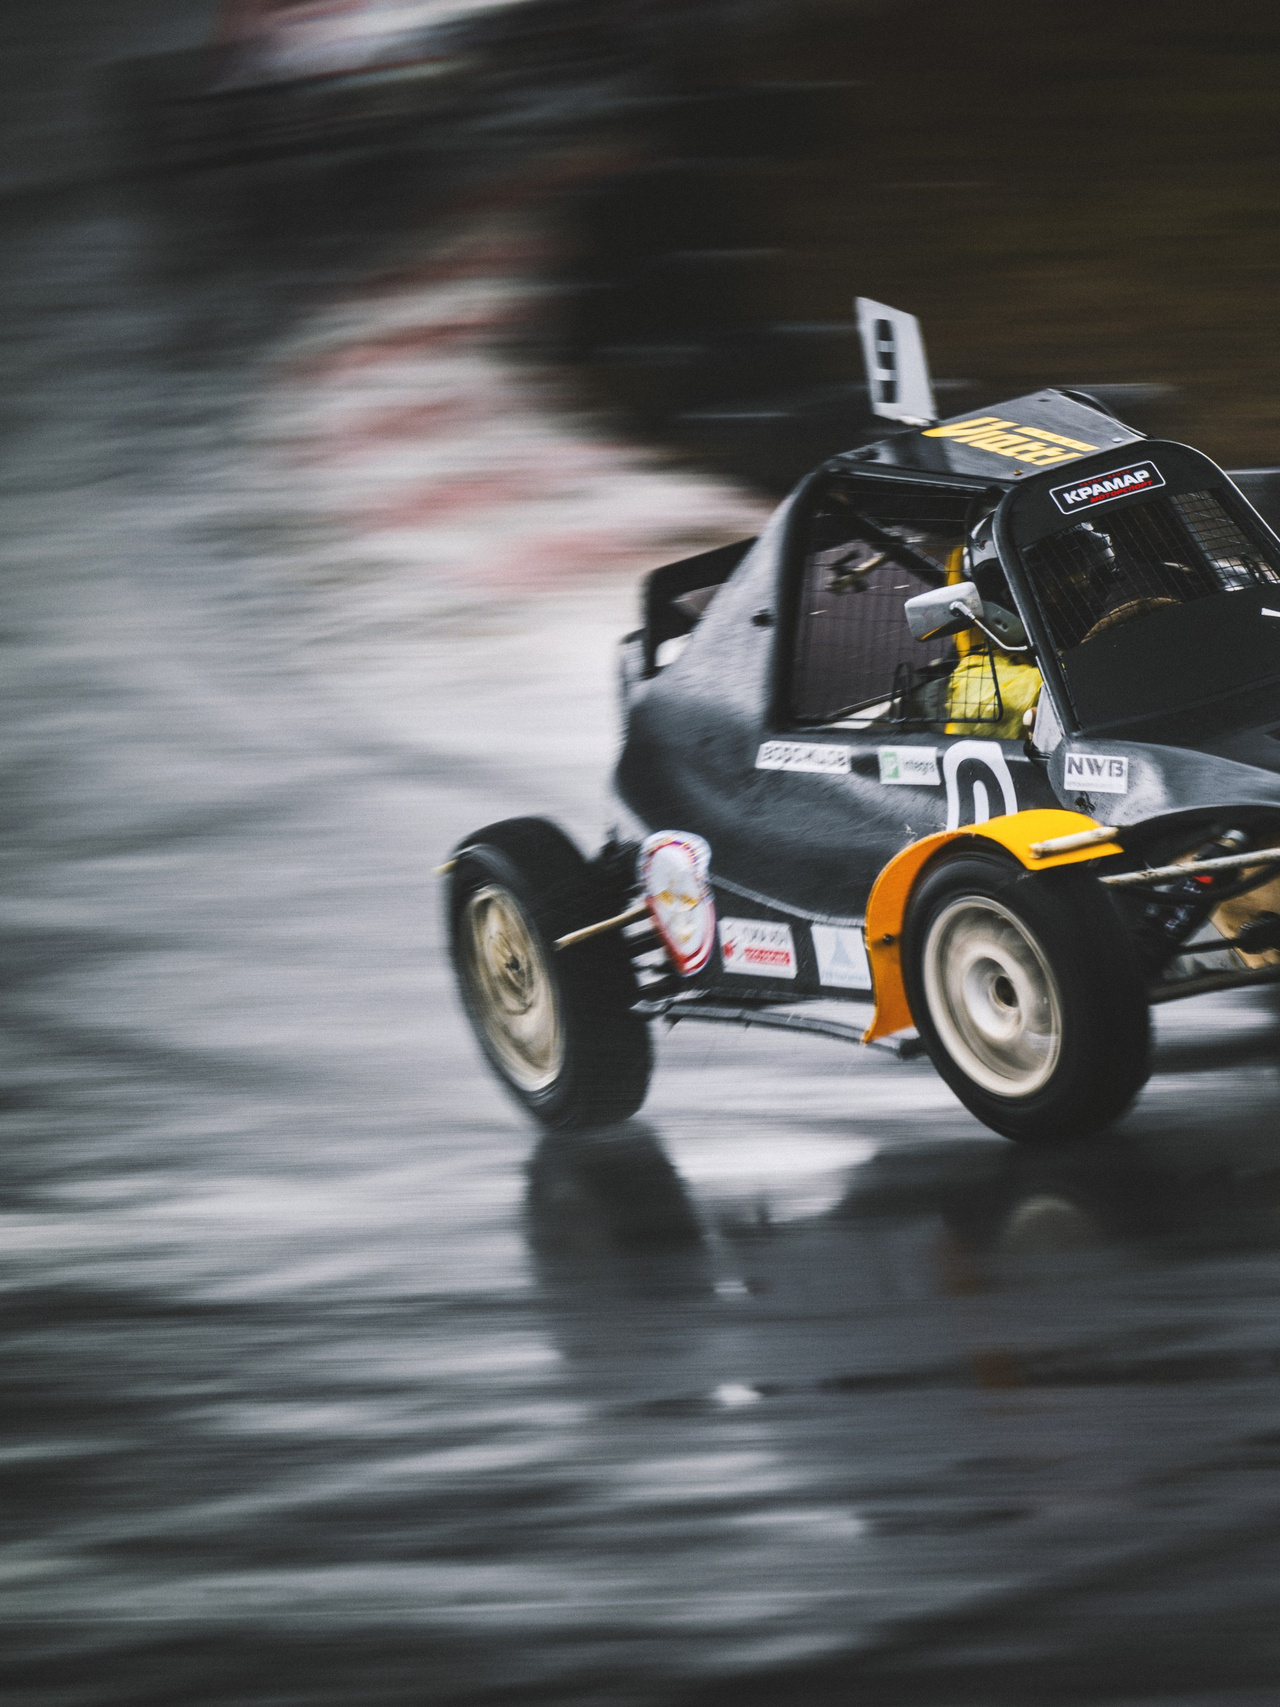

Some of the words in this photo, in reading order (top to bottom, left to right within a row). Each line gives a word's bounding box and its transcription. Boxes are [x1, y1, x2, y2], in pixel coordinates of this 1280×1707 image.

[921, 416, 1100, 467] Viatti
[1063, 469, 1150, 504] КРАМАР
[1089, 480, 1154, 503] МОТОРСПОРТ
[1067, 756, 1124, 778] NWB
